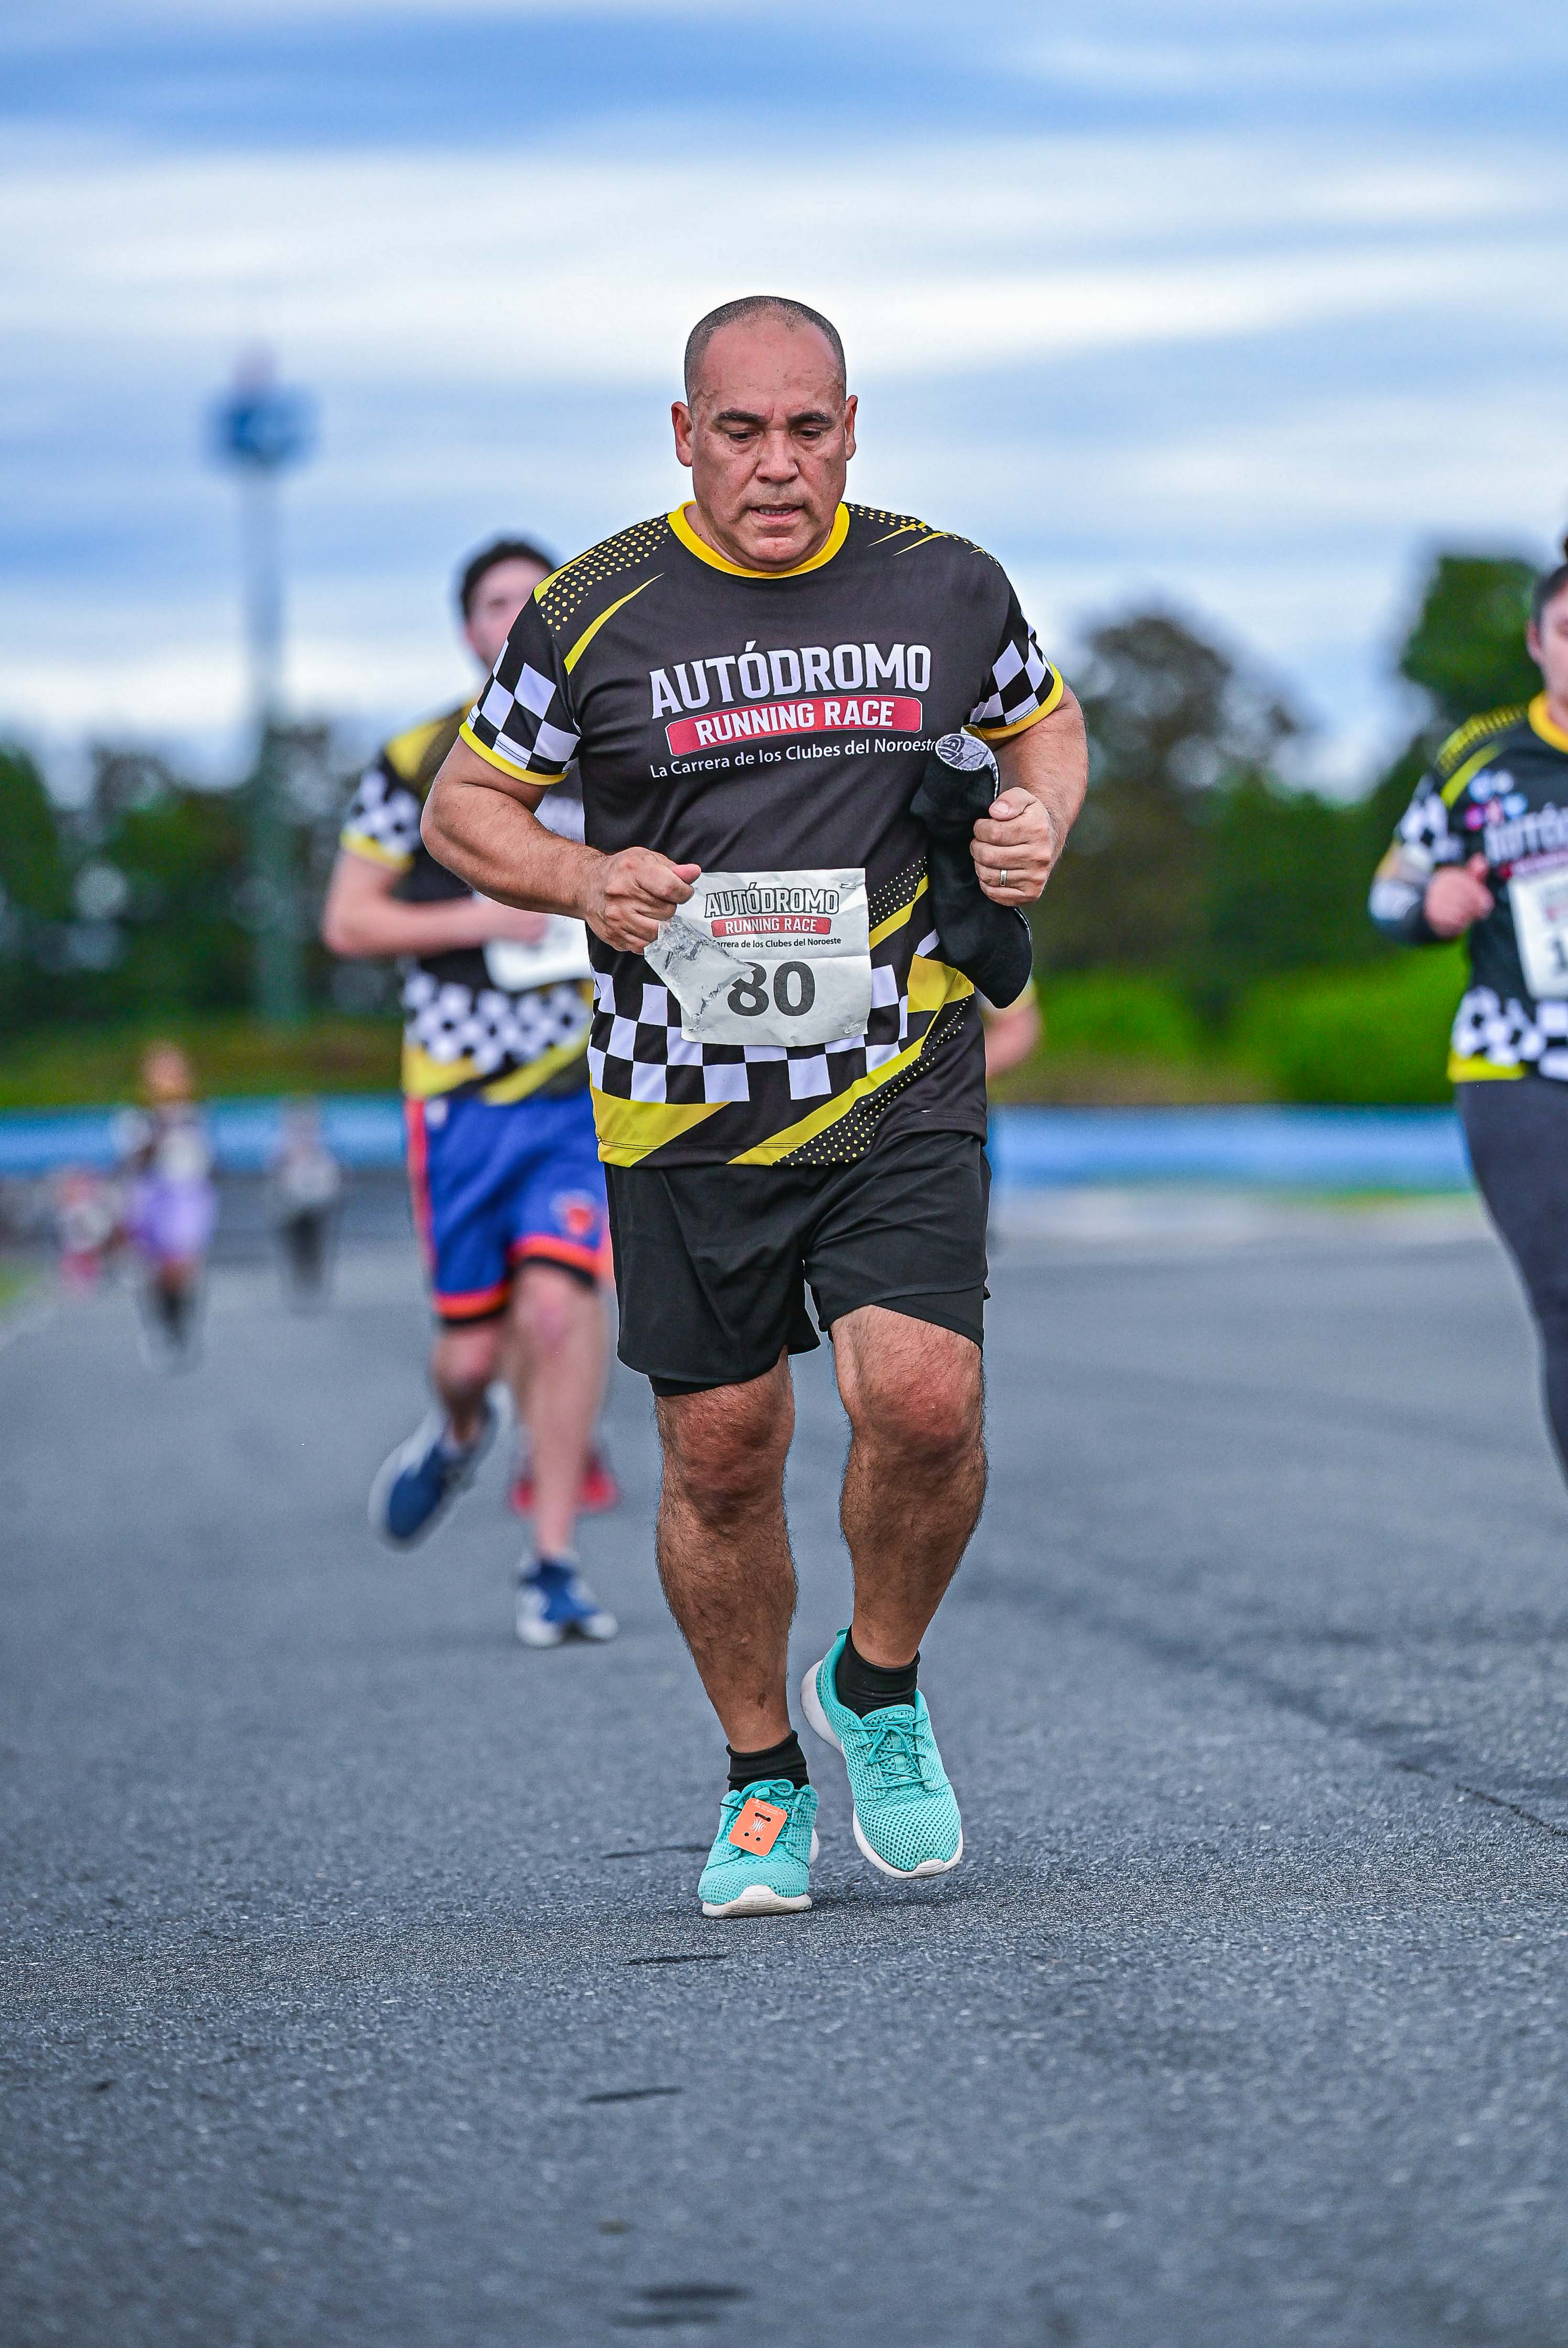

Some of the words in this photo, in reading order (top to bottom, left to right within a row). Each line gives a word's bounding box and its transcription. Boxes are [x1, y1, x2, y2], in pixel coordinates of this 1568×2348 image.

[649, 640, 932, 719] AUTÓDROMO
[694, 702, 815, 746] RUNNING
[824, 700, 895, 727] RACE
[650, 764, 668, 778] La
[671, 757, 730, 774] Carrera
[734, 752, 754, 766] de
[759, 749, 781, 762] los
[786, 745, 840, 760] Clubes
[844, 740, 870, 755] del
[704, 882, 839, 918] AUTÓDROMO
[725, 920, 780, 934] RUNNING
[784, 919, 816, 932] RACE
[765, 939, 792, 948] Clubes
[793, 938, 806, 946] del
[727, 961, 815, 1017] 80
